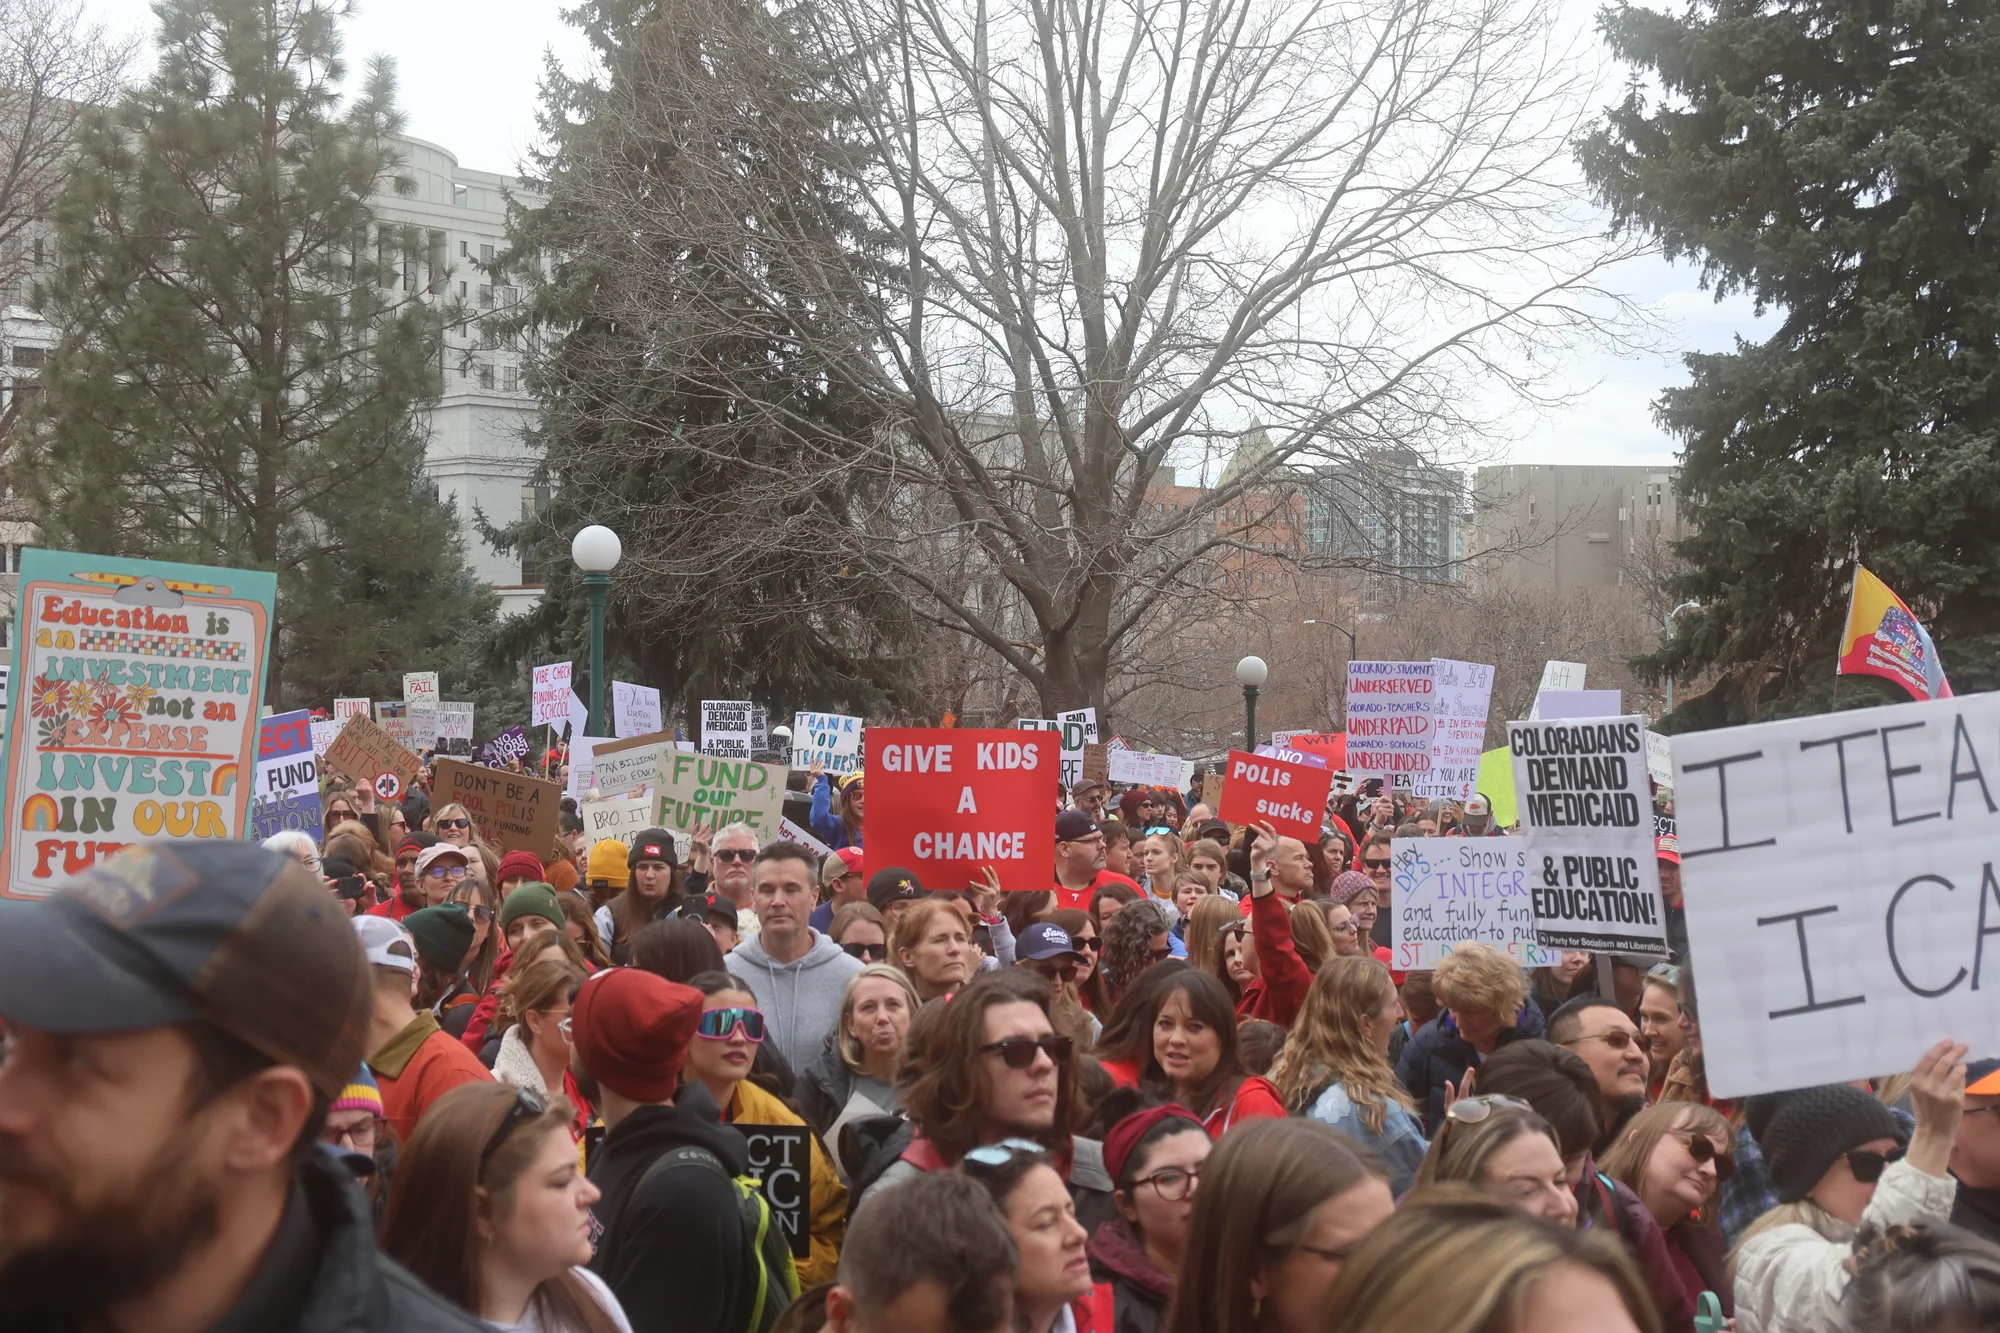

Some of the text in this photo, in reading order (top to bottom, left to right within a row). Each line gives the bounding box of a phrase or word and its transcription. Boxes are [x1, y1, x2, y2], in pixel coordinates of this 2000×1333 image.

[40, 596, 229, 636] Education is
[36, 628, 75, 649] an
[1896, 624, 1923, 647] Supp
[44, 656, 251, 695] INVESTMENT
[534, 665, 572, 684] VIBE CHECK
[1349, 663, 1392, 675] COLORADO
[1464, 664, 1487, 688] It
[1550, 665, 1572, 688] left
[410, 681, 434, 693] FAIL
[533, 687, 571, 705] FUNDING OUR
[1349, 678, 1432, 694] UNDERSERVED
[146, 696, 236, 721] not an
[336, 701, 369, 719] FUND
[702, 702, 751, 712] COLORADANS
[708, 711, 745, 722] DEMAND
[1347, 702, 1430, 712] COLORADO TEACHERS
[443, 723, 464, 735] YAY!
[706, 721, 748, 732] MEDICAID
[797, 712, 853, 733] THANK
[1348, 716, 1428, 736] UNDERPAID
[1449, 719, 1458, 728] IN
[63, 719, 208, 751] EXPENSE
[352, 714, 423, 774] ANYMORE CUTS
[493, 733, 511, 749] NO
[493, 733, 526, 757] MORE
[708, 739, 744, 749] & PUBLIC
[810, 730, 837, 749] YOU
[1303, 735, 1338, 746] WTF
[1347, 740, 1426, 750] COLORADO SCHOOLS
[1448, 731, 1484, 739] SPENDING
[1511, 723, 1640, 757] COLORADANS
[333, 736, 380, 781] BUTTS
[364, 743, 380, 756] OUT
[381, 756, 392, 766] ON
[393, 765, 406, 777] OUR
[488, 742, 530, 769] CUTS!
[702, 749, 749, 759] EDUCATION!
[794, 748, 855, 772] TEACHERS
[882, 742, 1039, 773] GIVE KIDS
[1276, 749, 1303, 764] NO
[1444, 745, 1454, 755] IN
[595, 760, 618, 773] TAX
[672, 755, 768, 791] FUND
[1347, 752, 1431, 772] UNDERFUNDED
[1527, 756, 1628, 791] DEMAND
[36, 752, 211, 796] INVEST
[267, 761, 316, 792] FUND
[600, 774, 627, 789] FUND
[1439, 768, 1455, 782] YOU
[1457, 768, 1475, 782] ARE
[454, 771, 540, 804] DON'T BE A
[693, 788, 738, 806] our
[1415, 783, 1470, 798] CUTTING $
[1680, 713, 2000, 859] I TEA
[452, 791, 535, 821] FOOL POLIS
[957, 786, 977, 813] A
[1526, 793, 1640, 827] MEDICAID
[57, 796, 227, 838] IN OUR
[593, 805, 651, 830] BRO, IT'
[1256, 799, 1314, 824] sucks
[494, 821, 532, 836] FUNDING
[913, 832, 1025, 860] CHANCE
[1392, 843, 1419, 872] Hey
[1460, 846, 1507, 869] Show
[1543, 856, 1639, 890] & PUBLIC
[1403, 900, 1532, 929] and fully fun
[1531, 888, 1658, 925] EDUCATION!
[1513, 922, 1536, 944] put
[1550, 937, 1665, 951] Party for Socialism and Liberation
[1757, 905, 1866, 1019] I
